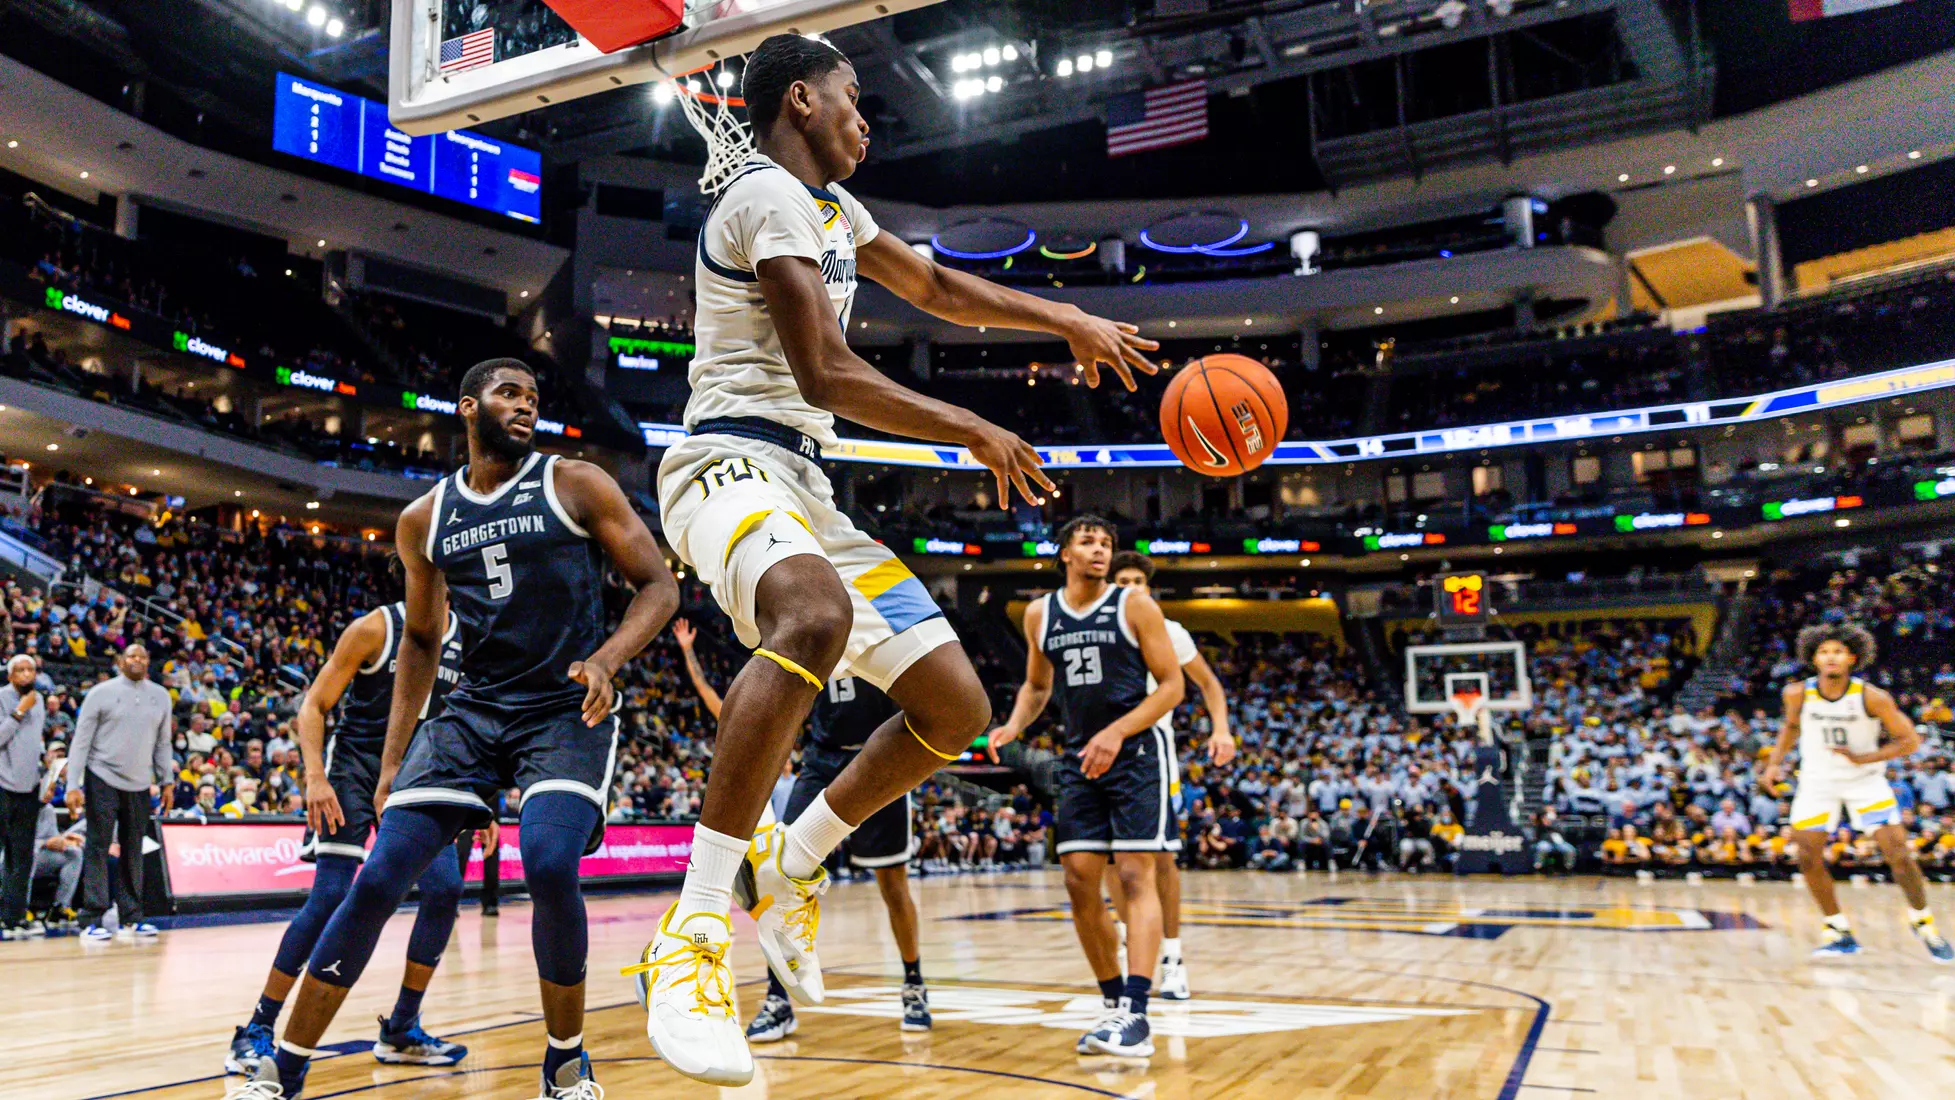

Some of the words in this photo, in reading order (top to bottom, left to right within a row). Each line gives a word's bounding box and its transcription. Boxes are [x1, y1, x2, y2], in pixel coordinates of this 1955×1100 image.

[62, 294, 109, 323] clover
[186, 336, 228, 363] clover
[289, 369, 337, 392] clover
[416, 391, 458, 415] clover
[1231, 398, 1264, 456] ELITE
[1780, 497, 1836, 517] clover
[1504, 523, 1554, 539] clover
[1632, 512, 1685, 530] clover
[442, 514, 546, 556] GEORGETOWN
[926, 537, 964, 554] clover
[1148, 538, 1192, 554] clover
[1257, 537, 1300, 553] clover
[1377, 531, 1424, 549] clover
[481, 543, 514, 600] 5
[1453, 588, 1480, 615] 12
[1047, 629, 1117, 651] GEORGETOWN
[1063, 645, 1104, 687] 23
[828, 675, 857, 704] 13
[1821, 726, 1848, 747] 10
[1462, 830, 1524, 856] meijer
